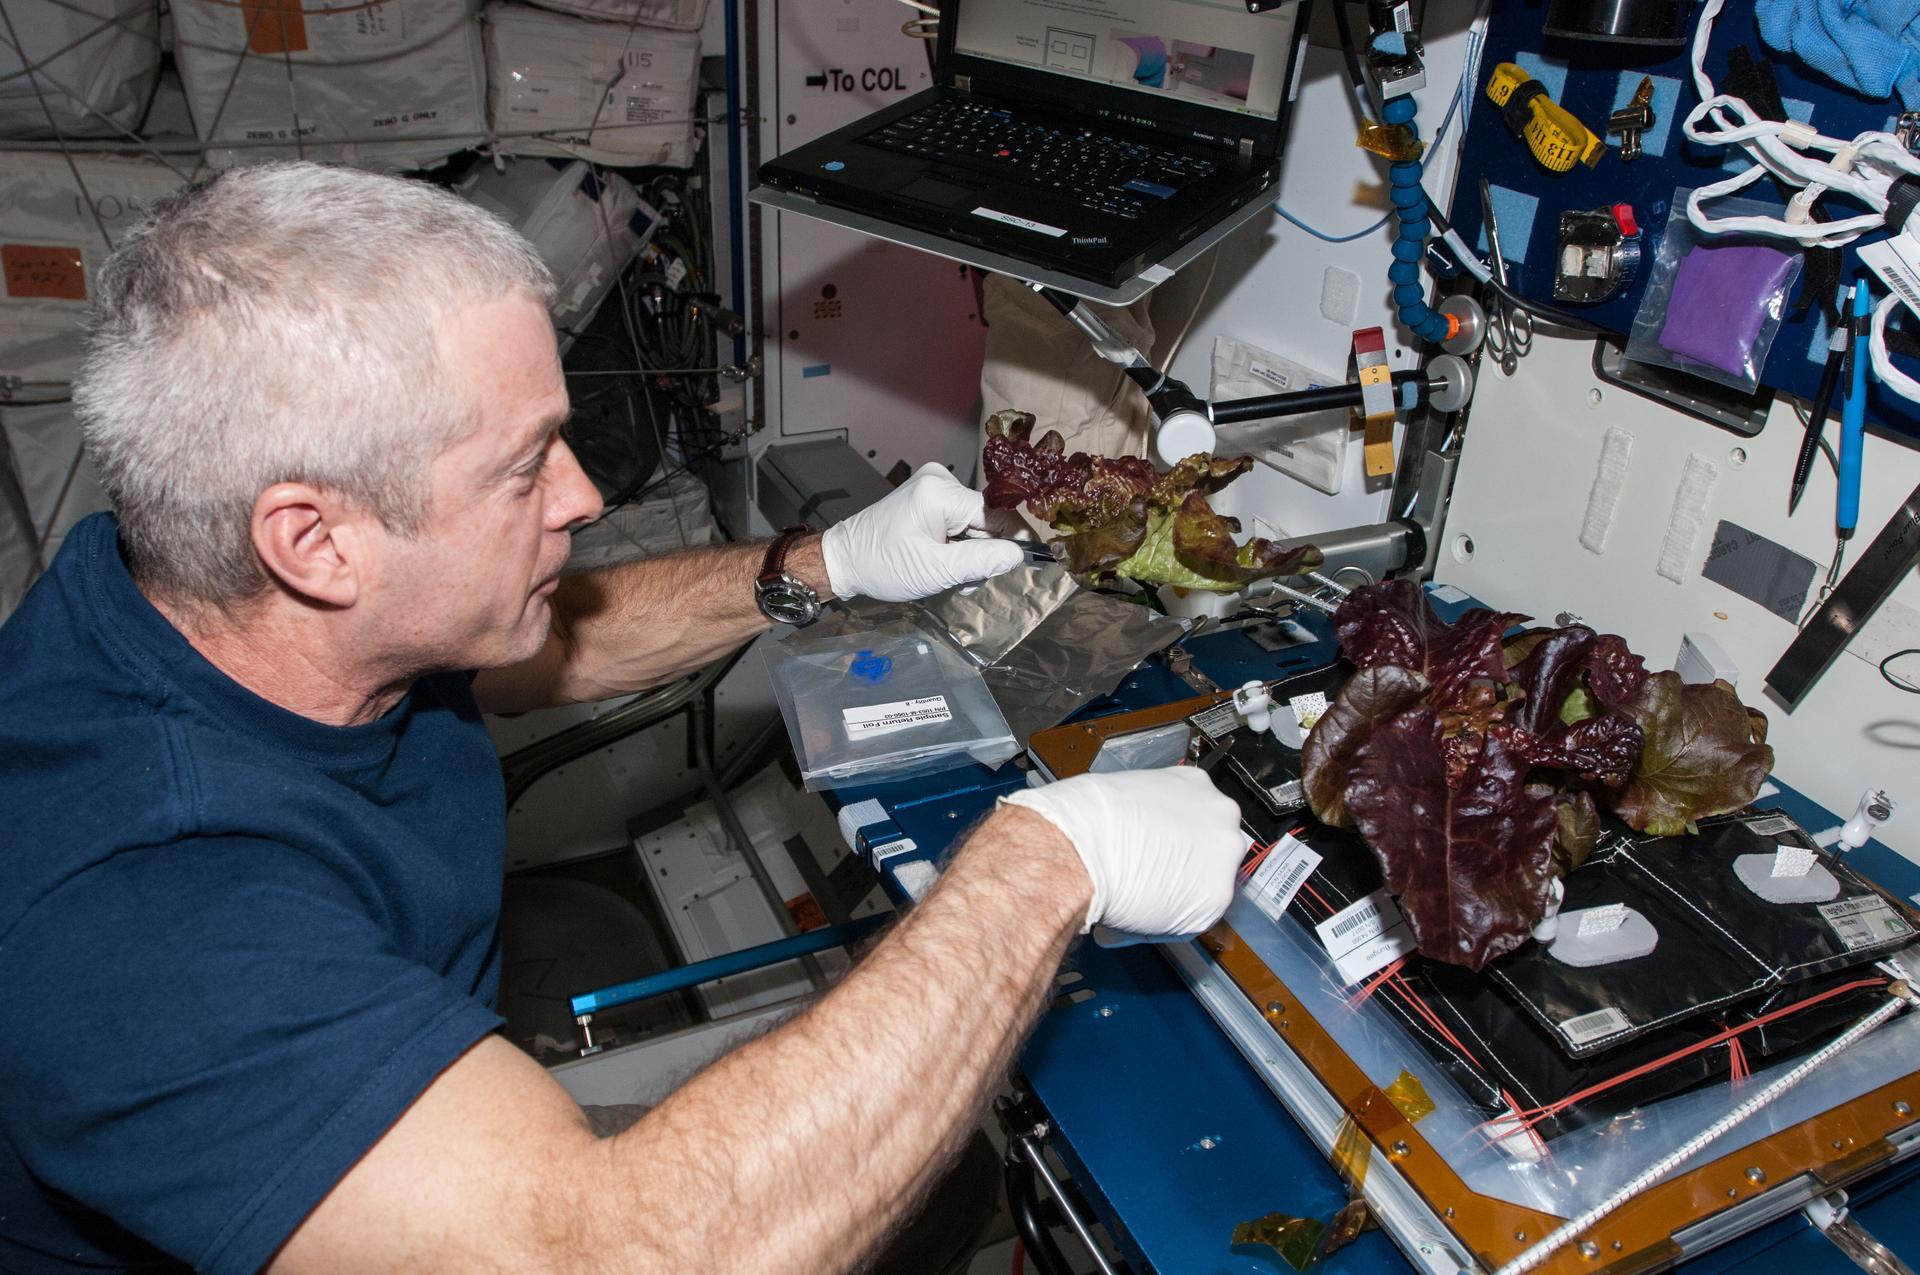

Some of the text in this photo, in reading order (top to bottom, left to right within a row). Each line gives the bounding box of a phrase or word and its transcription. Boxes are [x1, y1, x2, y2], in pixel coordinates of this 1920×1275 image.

[628, 52, 653, 68] 115
[828, 67, 907, 92] To COL
[915, 697, 942, 705] Quantity
[915, 712, 950, 721] Sample
[882, 717, 914, 726] Return
